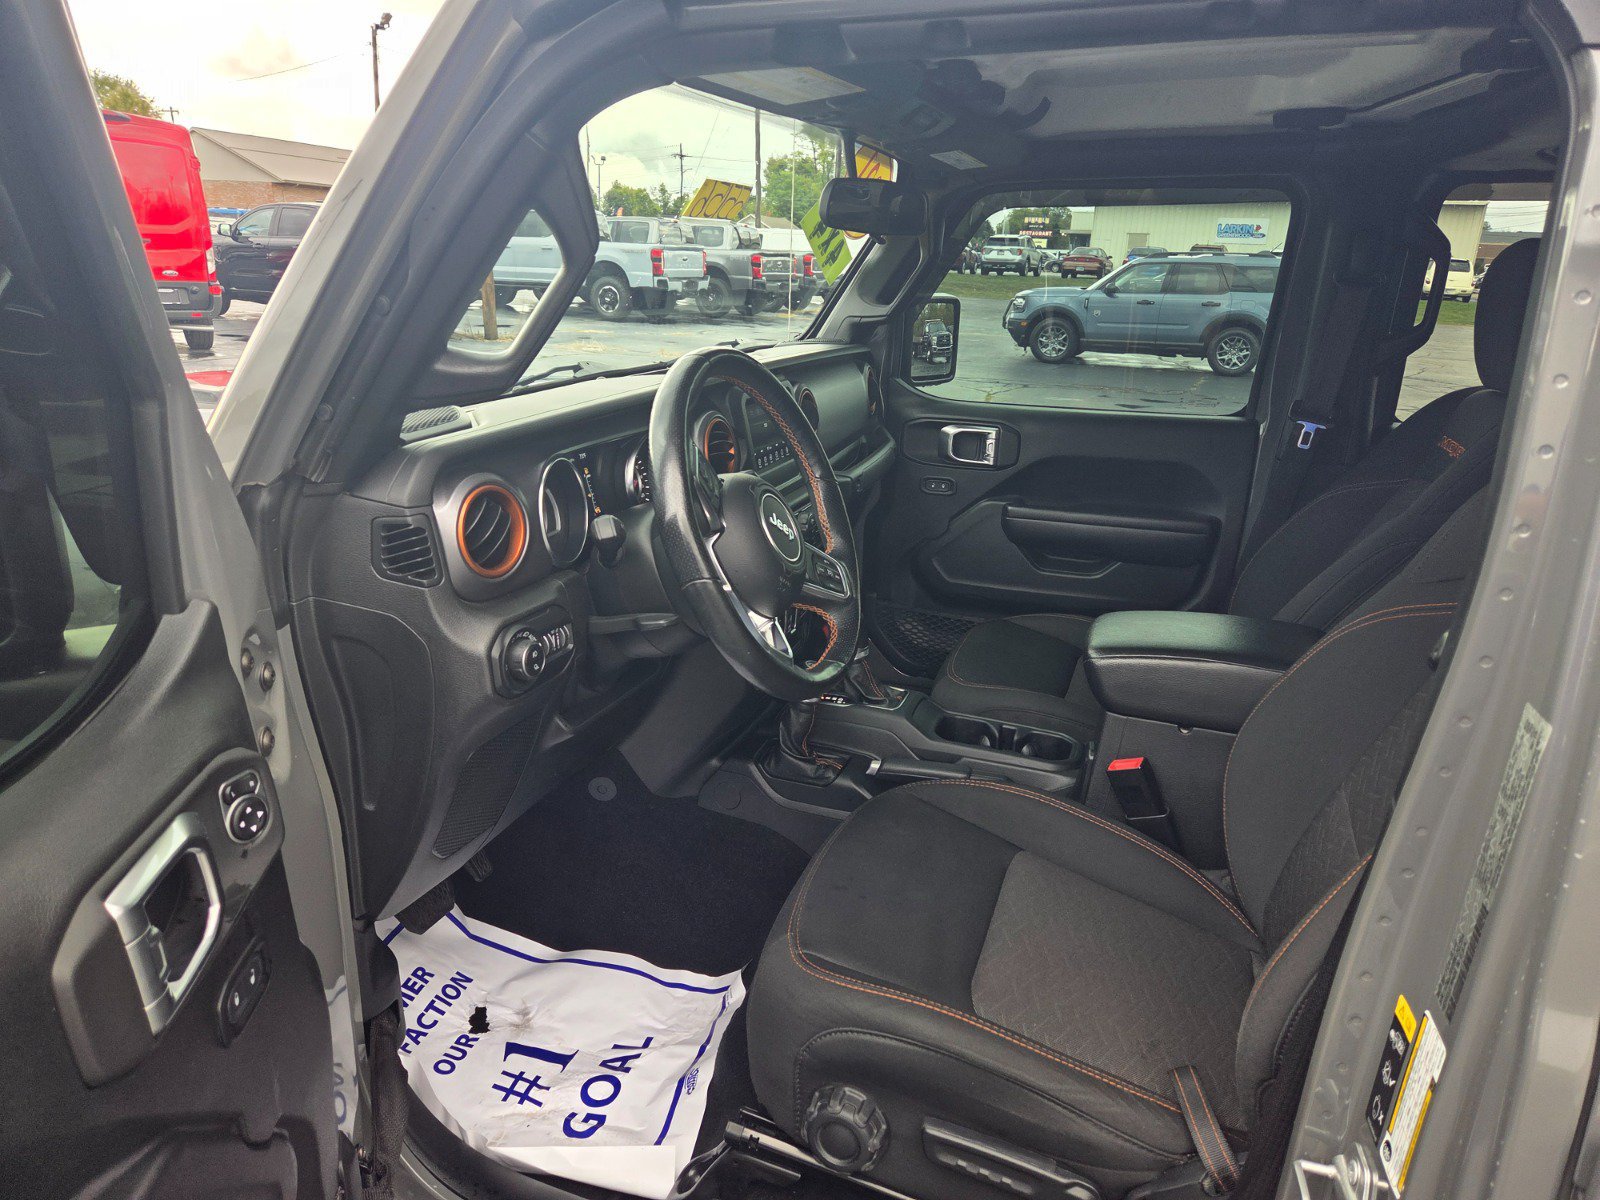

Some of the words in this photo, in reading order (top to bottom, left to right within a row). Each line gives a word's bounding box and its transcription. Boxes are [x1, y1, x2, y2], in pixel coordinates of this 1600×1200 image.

[1217, 223, 1255, 234] LARKIN
[770, 512, 795, 540] Jeep
[433, 1034, 480, 1075] OUR
[491, 1041, 579, 1108] #1
[562, 1036, 654, 1139] GOAL
